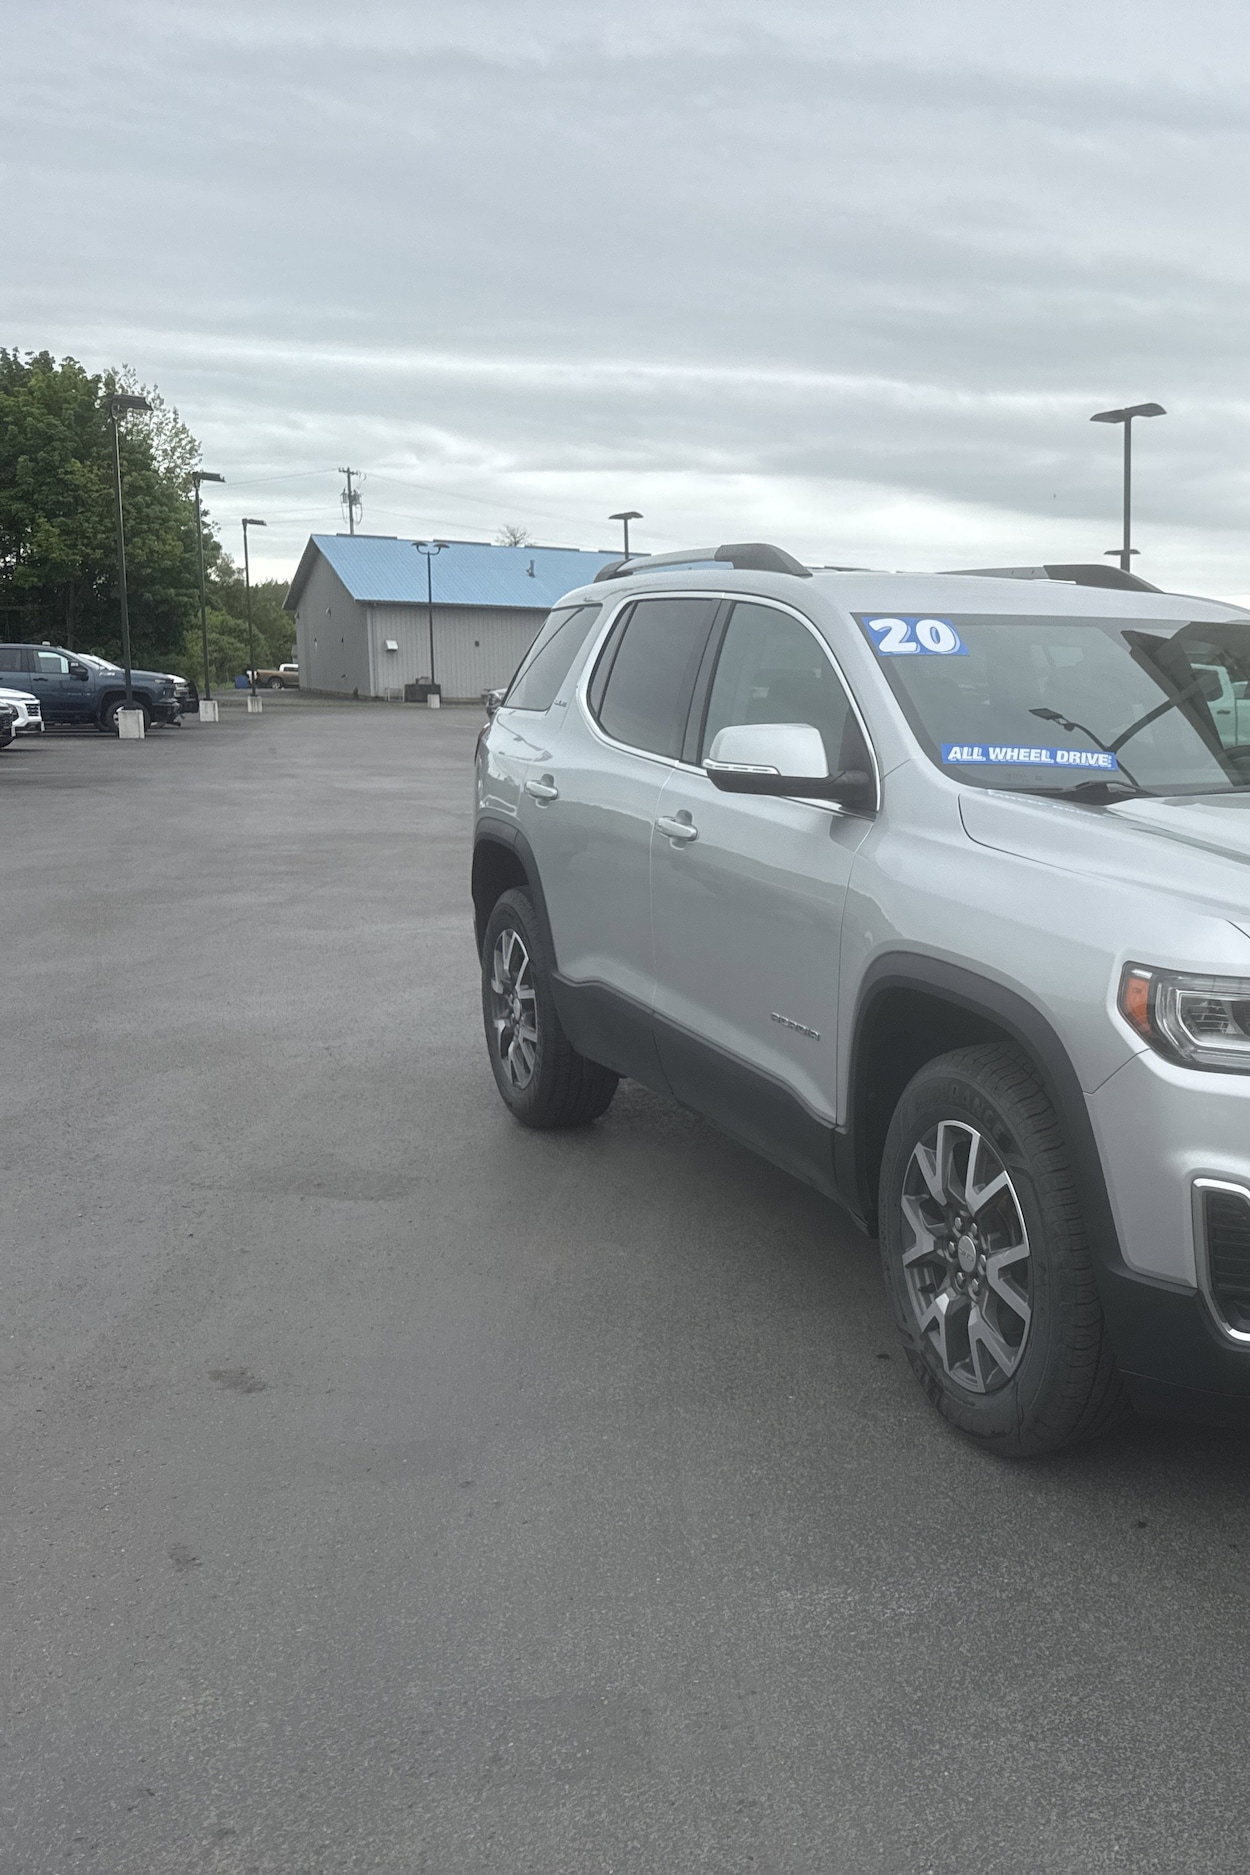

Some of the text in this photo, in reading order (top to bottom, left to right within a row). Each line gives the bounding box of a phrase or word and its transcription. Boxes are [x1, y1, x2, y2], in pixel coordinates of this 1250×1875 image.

[868, 617, 960, 654] 20
[948, 746, 1112, 768] ALL WHEEL DRIVE
